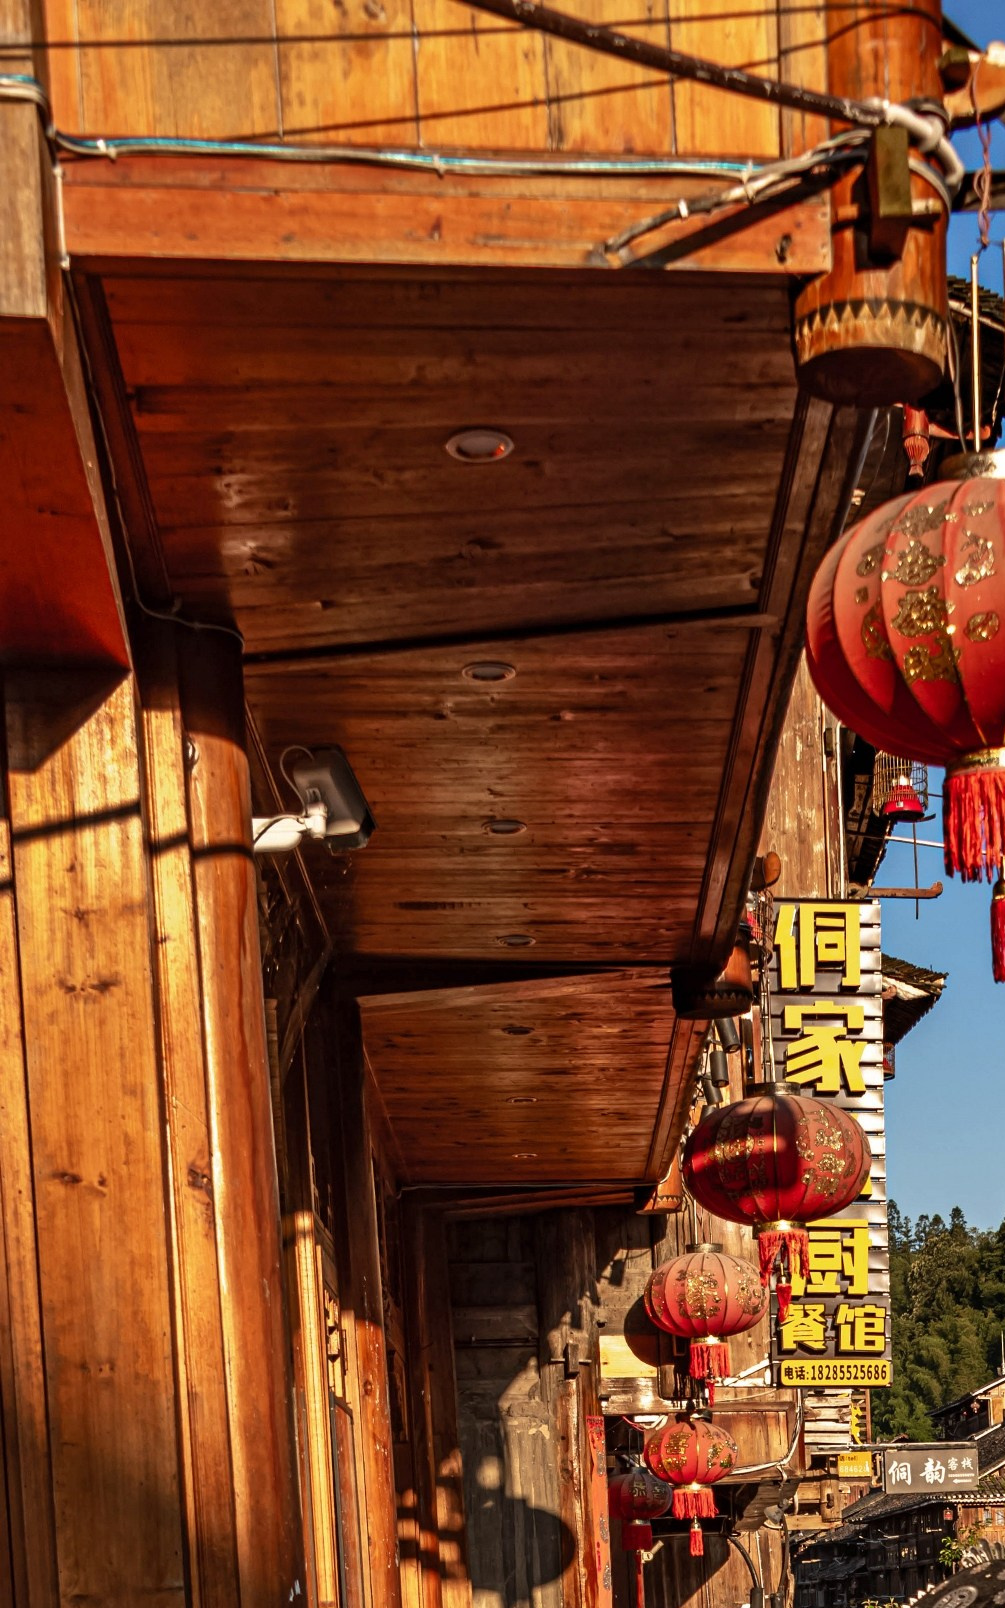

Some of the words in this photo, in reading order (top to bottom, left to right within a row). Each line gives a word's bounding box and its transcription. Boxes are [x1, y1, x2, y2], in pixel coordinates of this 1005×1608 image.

[780, 1303, 885, 1352] 餐馆
[784, 1364, 887, 1381] 电话:18285525686
[888, 1457, 946, 1486] 侗韵
[948, 1457, 974, 1471] 客栈
